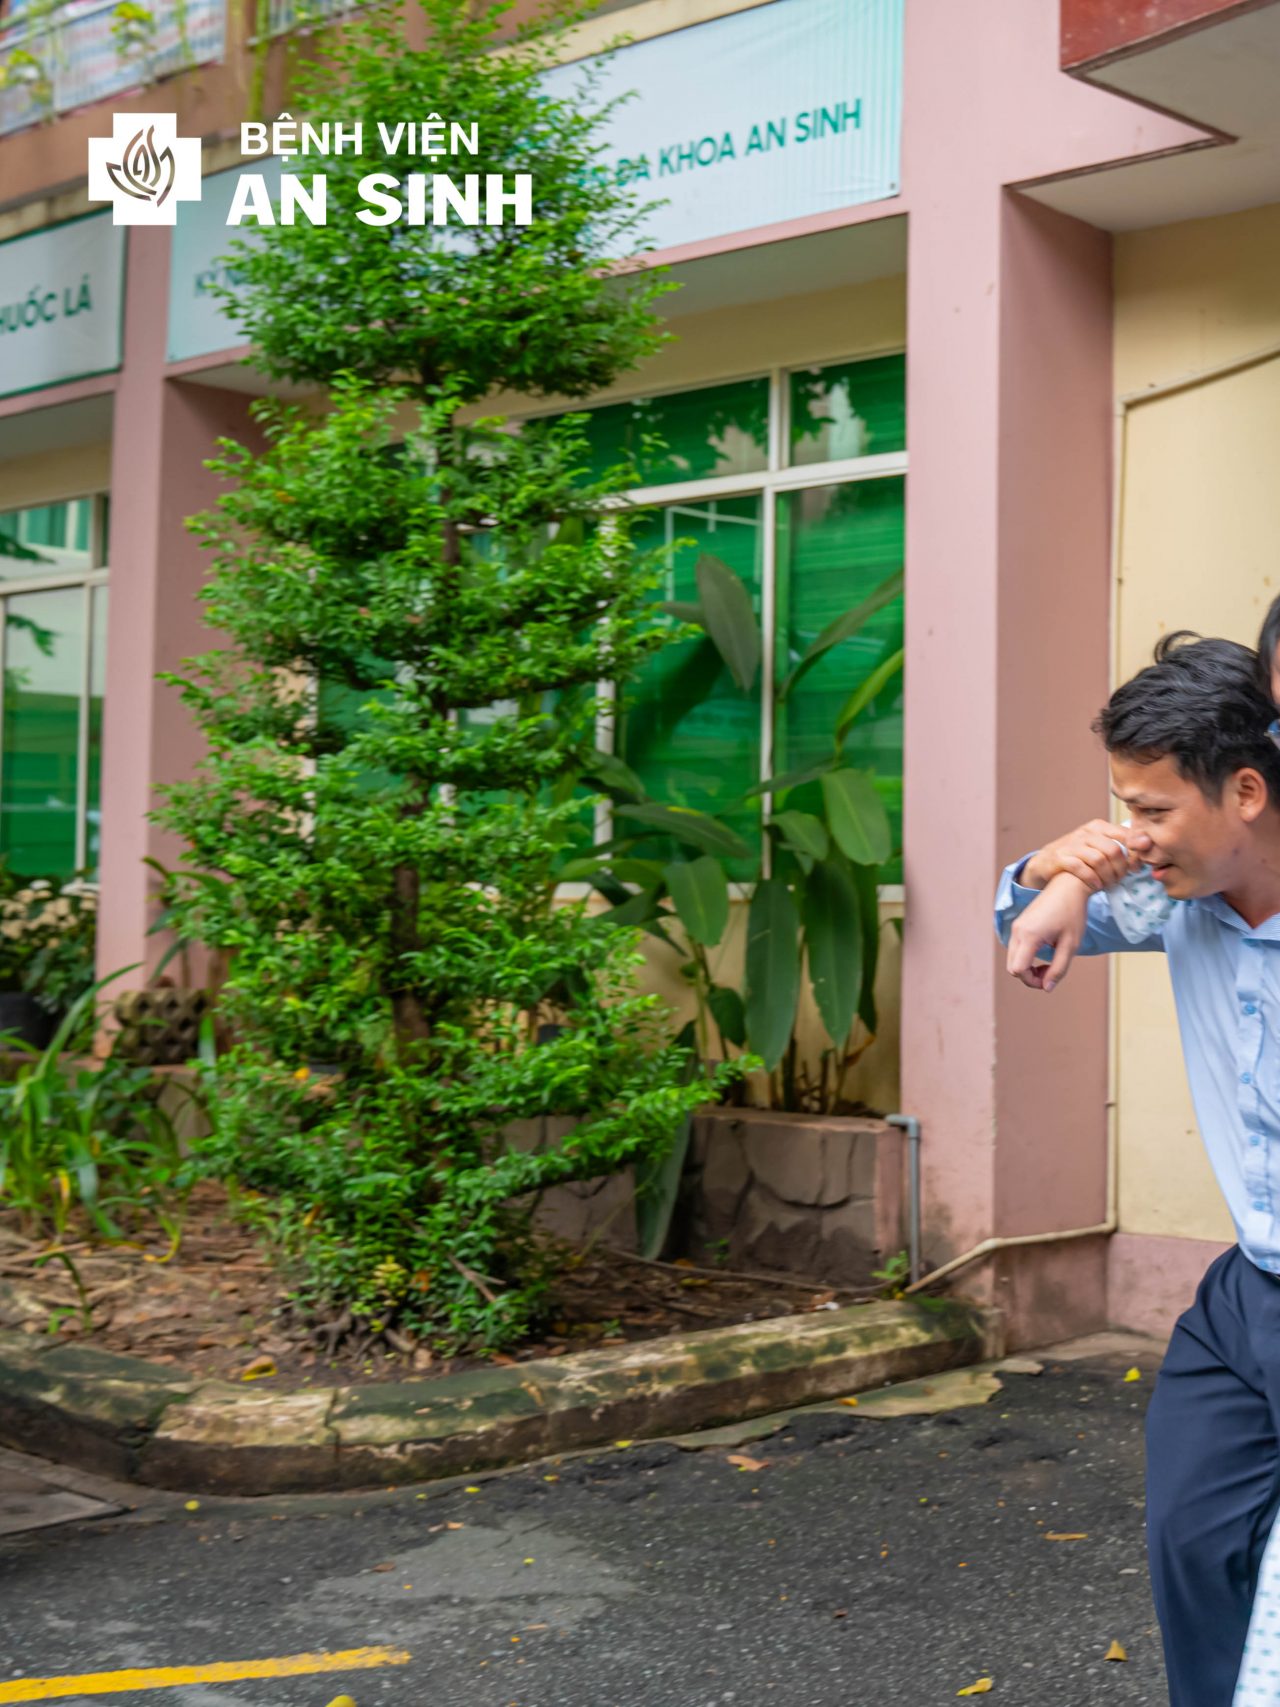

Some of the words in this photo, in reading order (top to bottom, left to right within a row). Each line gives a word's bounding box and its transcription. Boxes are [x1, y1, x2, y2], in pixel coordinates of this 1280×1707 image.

[659, 132, 736, 177] KHOA
[745, 117, 787, 156] AN
[794, 98, 862, 142] SINH
[64, 272, 93, 318] LÁ
